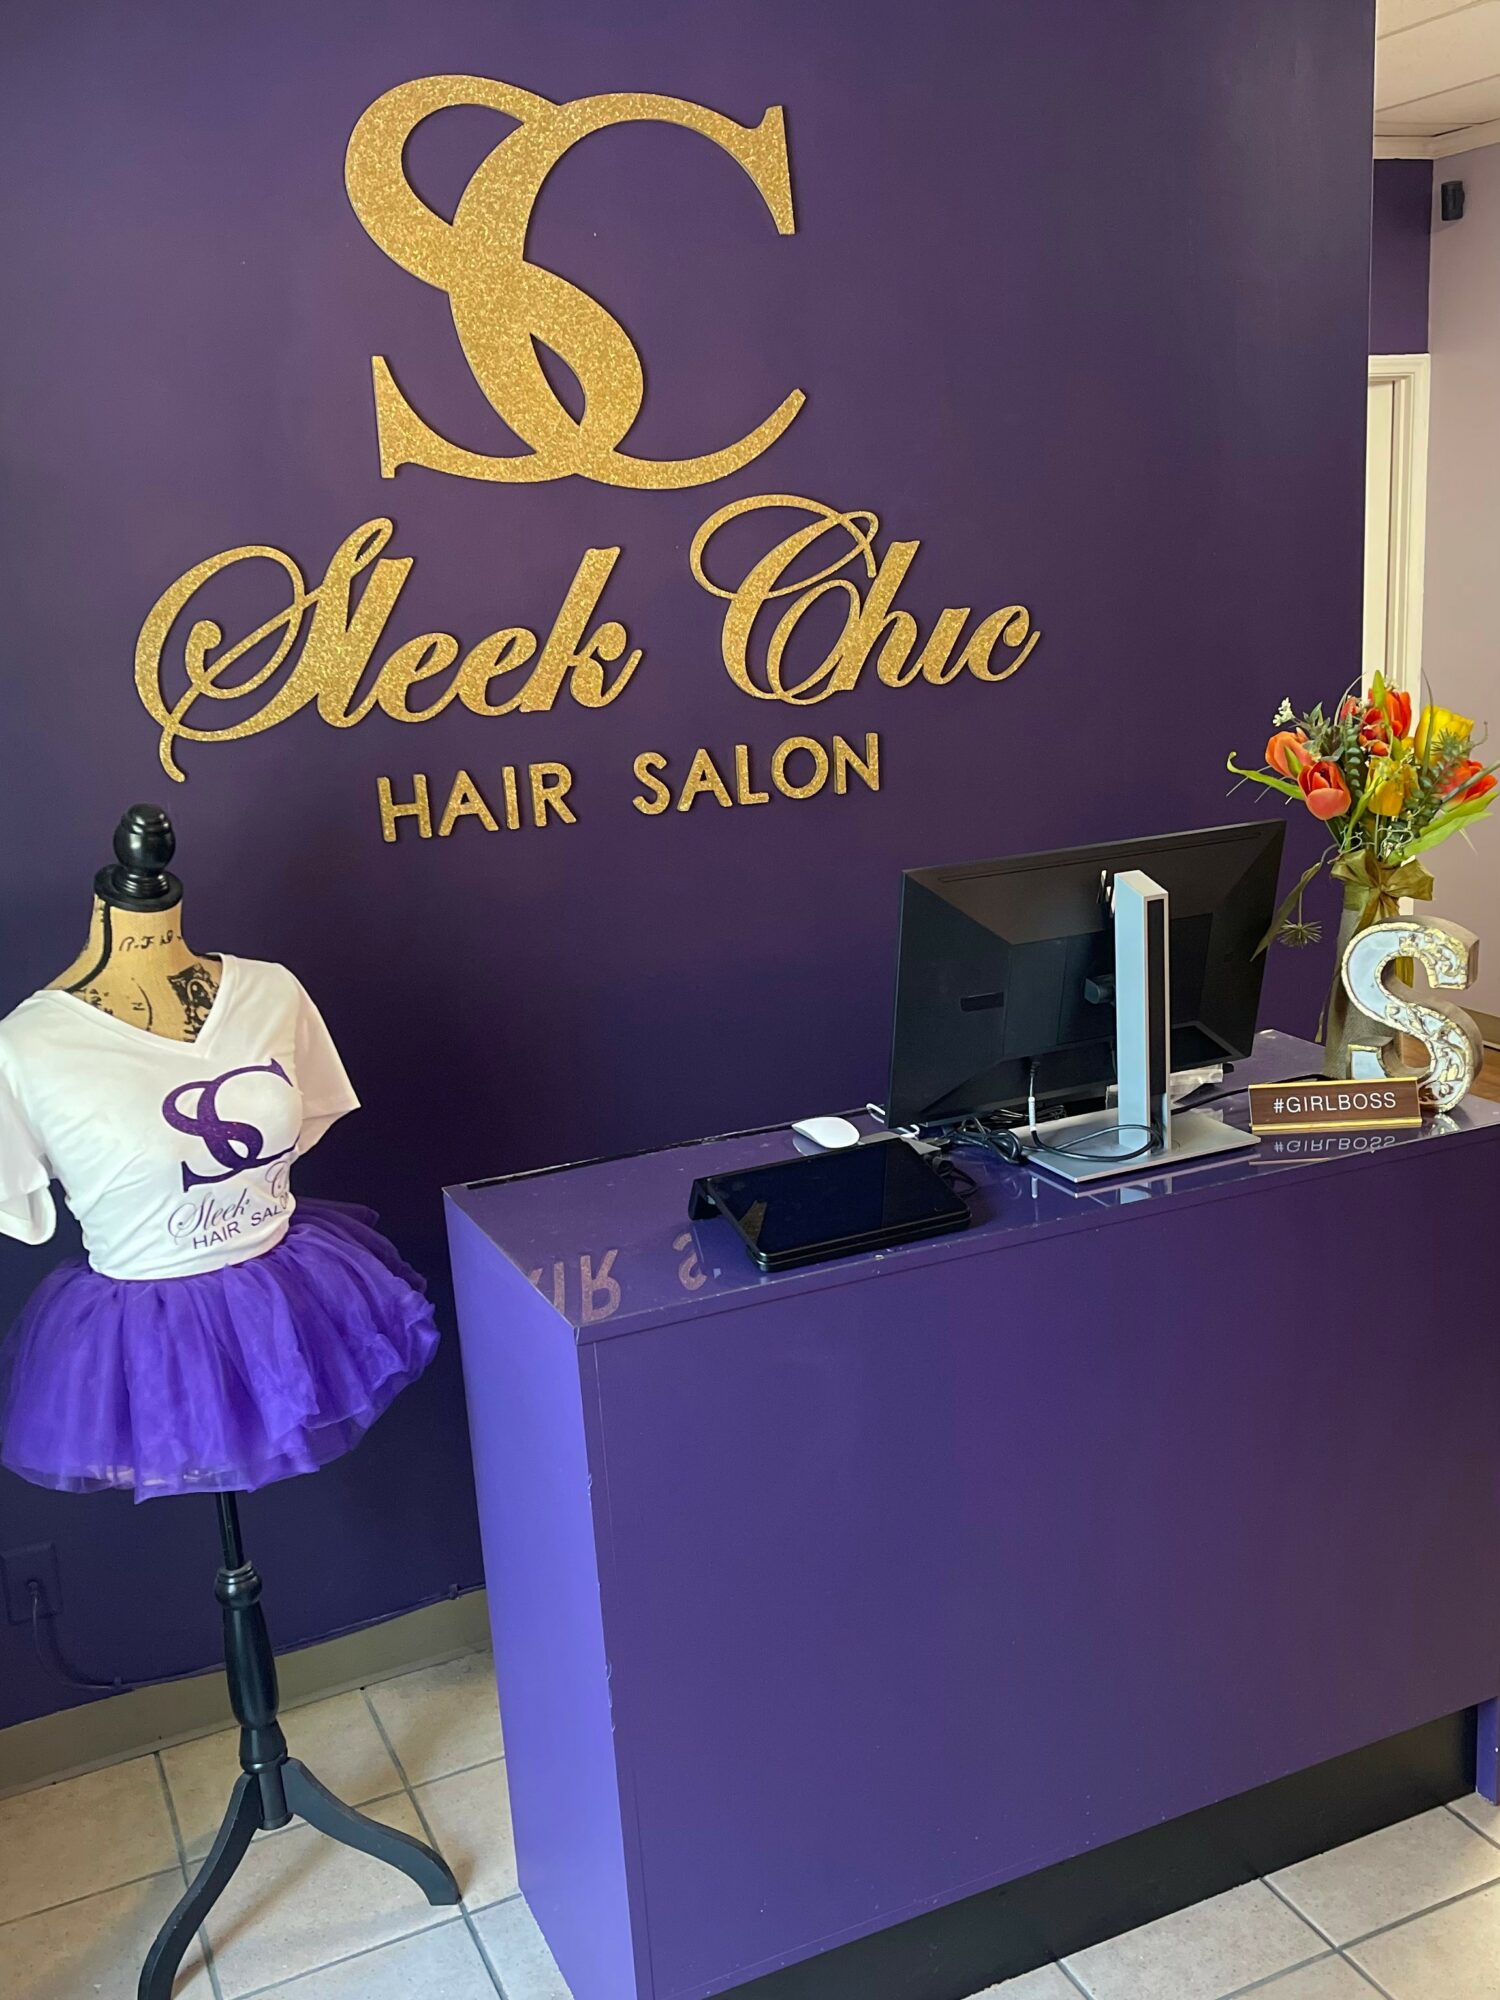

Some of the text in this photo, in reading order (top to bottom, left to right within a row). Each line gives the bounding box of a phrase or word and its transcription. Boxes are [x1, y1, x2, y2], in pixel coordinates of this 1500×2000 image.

[345, 73, 807, 491] SC
[133, 492, 1042, 784] Sleek Chic
[377, 731, 882, 844] HAIR SALON
[1341, 916, 1479, 1113] S
[1273, 1091, 1397, 1114] #GIRLBOSS
[168, 1191, 250, 1246] Sleek
[193, 1221, 241, 1250] HAIR
